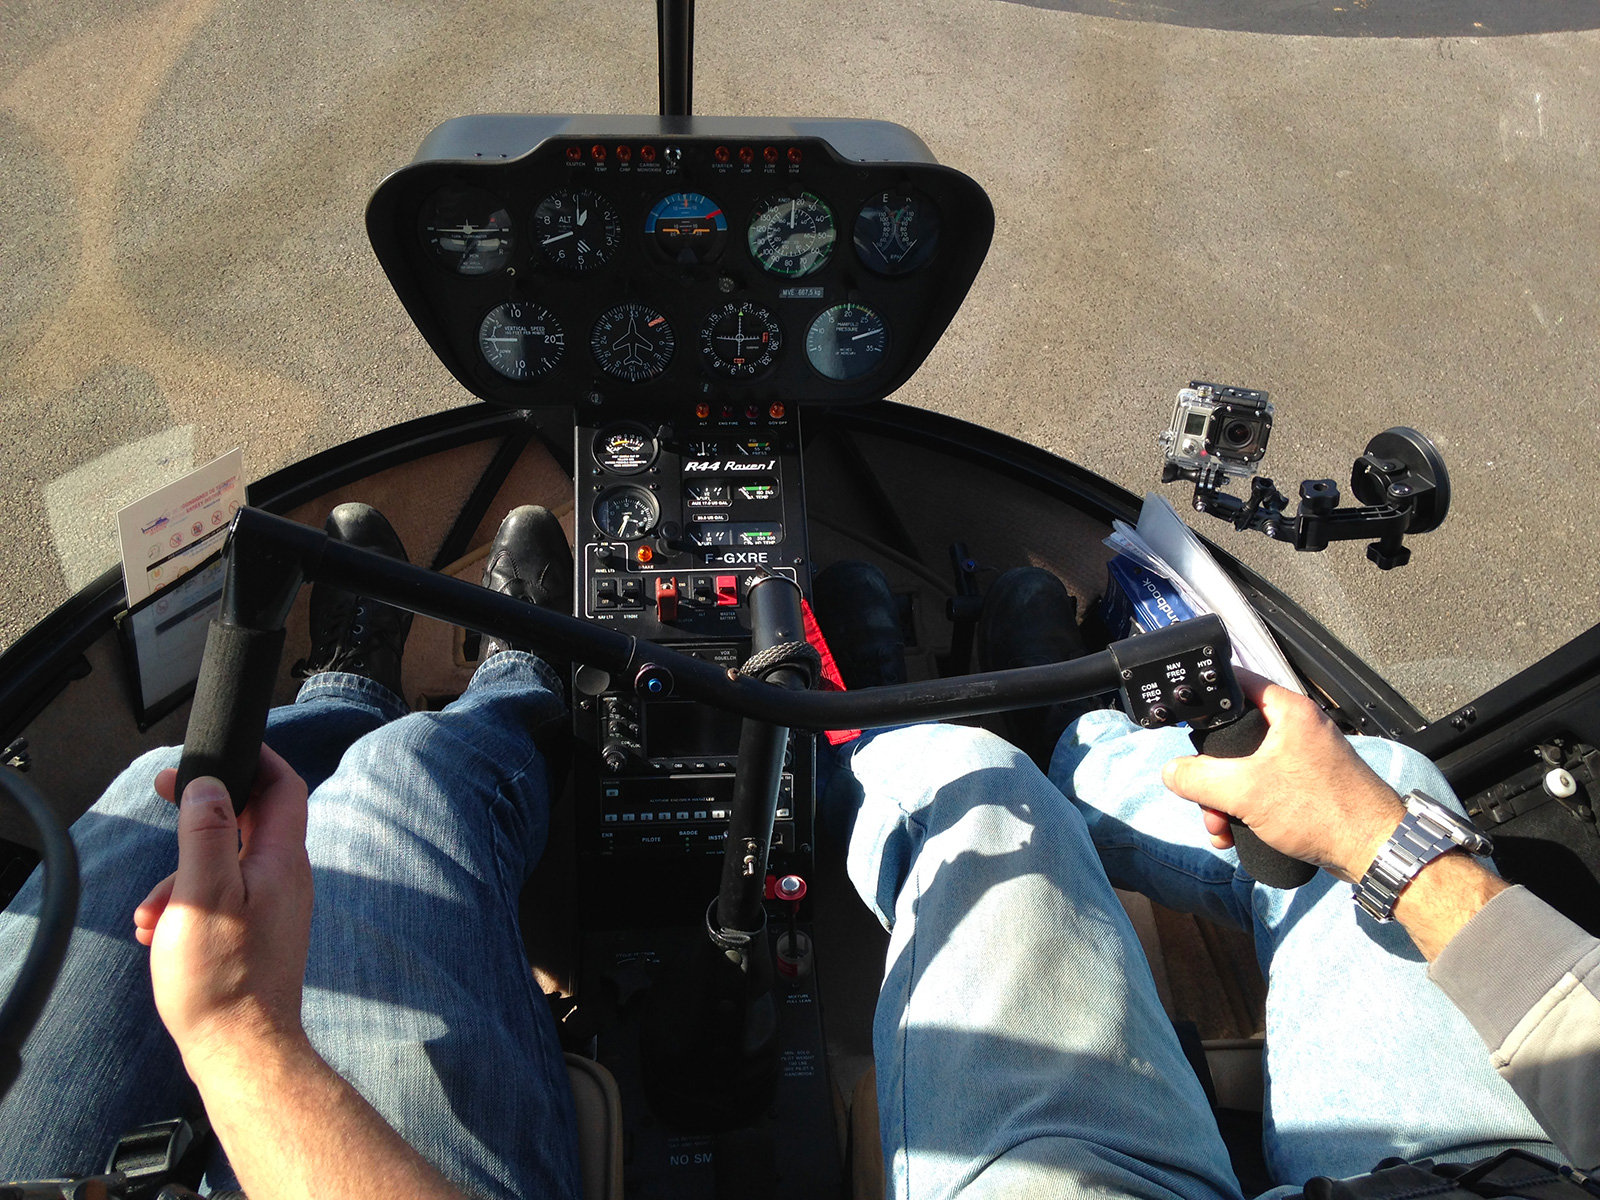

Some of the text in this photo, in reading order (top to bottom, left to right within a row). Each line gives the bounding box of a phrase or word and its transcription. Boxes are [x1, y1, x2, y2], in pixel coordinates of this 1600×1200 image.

[883, 193, 889, 203] E
[554, 199, 562, 209] 9
[543, 215, 552, 225] 8
[558, 216, 572, 224] ALT
[604, 211, 611, 221] 2
[606, 236, 613, 246] 3
[558, 249, 566, 259] 6
[595, 249, 603, 258] 4
[811, 247, 820, 255] 60
[577, 255, 585, 265] 5
[800, 257, 808, 265] 70
[724, 303, 734, 312] 18
[742, 302, 753, 311] 21
[510, 309, 522, 318] 10
[614, 313, 624, 322] 30
[709, 312, 719, 323] 15
[759, 309, 770, 319] 24
[769, 323, 780, 333] 27
[701, 329, 710, 338] 12
[544, 335, 556, 344] 20
[770, 340, 779, 351] 30
[653, 352, 662, 361] E
[761, 355, 772, 366] 33
[515, 360, 526, 369] 10
[614, 360, 622, 368] S
[713, 360, 721, 368] 6
[730, 368, 737, 376] 3
[748, 366, 755, 374] 0
[684, 460, 721, 472] R44
[723, 460, 766, 472] Raven
[181, 491, 208, 509] CONSIGNES
[705, 552, 768, 565] F-GXRE
[744, 575, 755, 587] OFF
[1166, 662, 1182, 672] NAV
[1197, 658, 1213, 669] HYD
[1166, 668, 1187, 679] FREQ
[1141, 682, 1159, 692] COM
[1141, 689, 1162, 700] FREQ
[670, 1152, 713, 1166] NO SM
